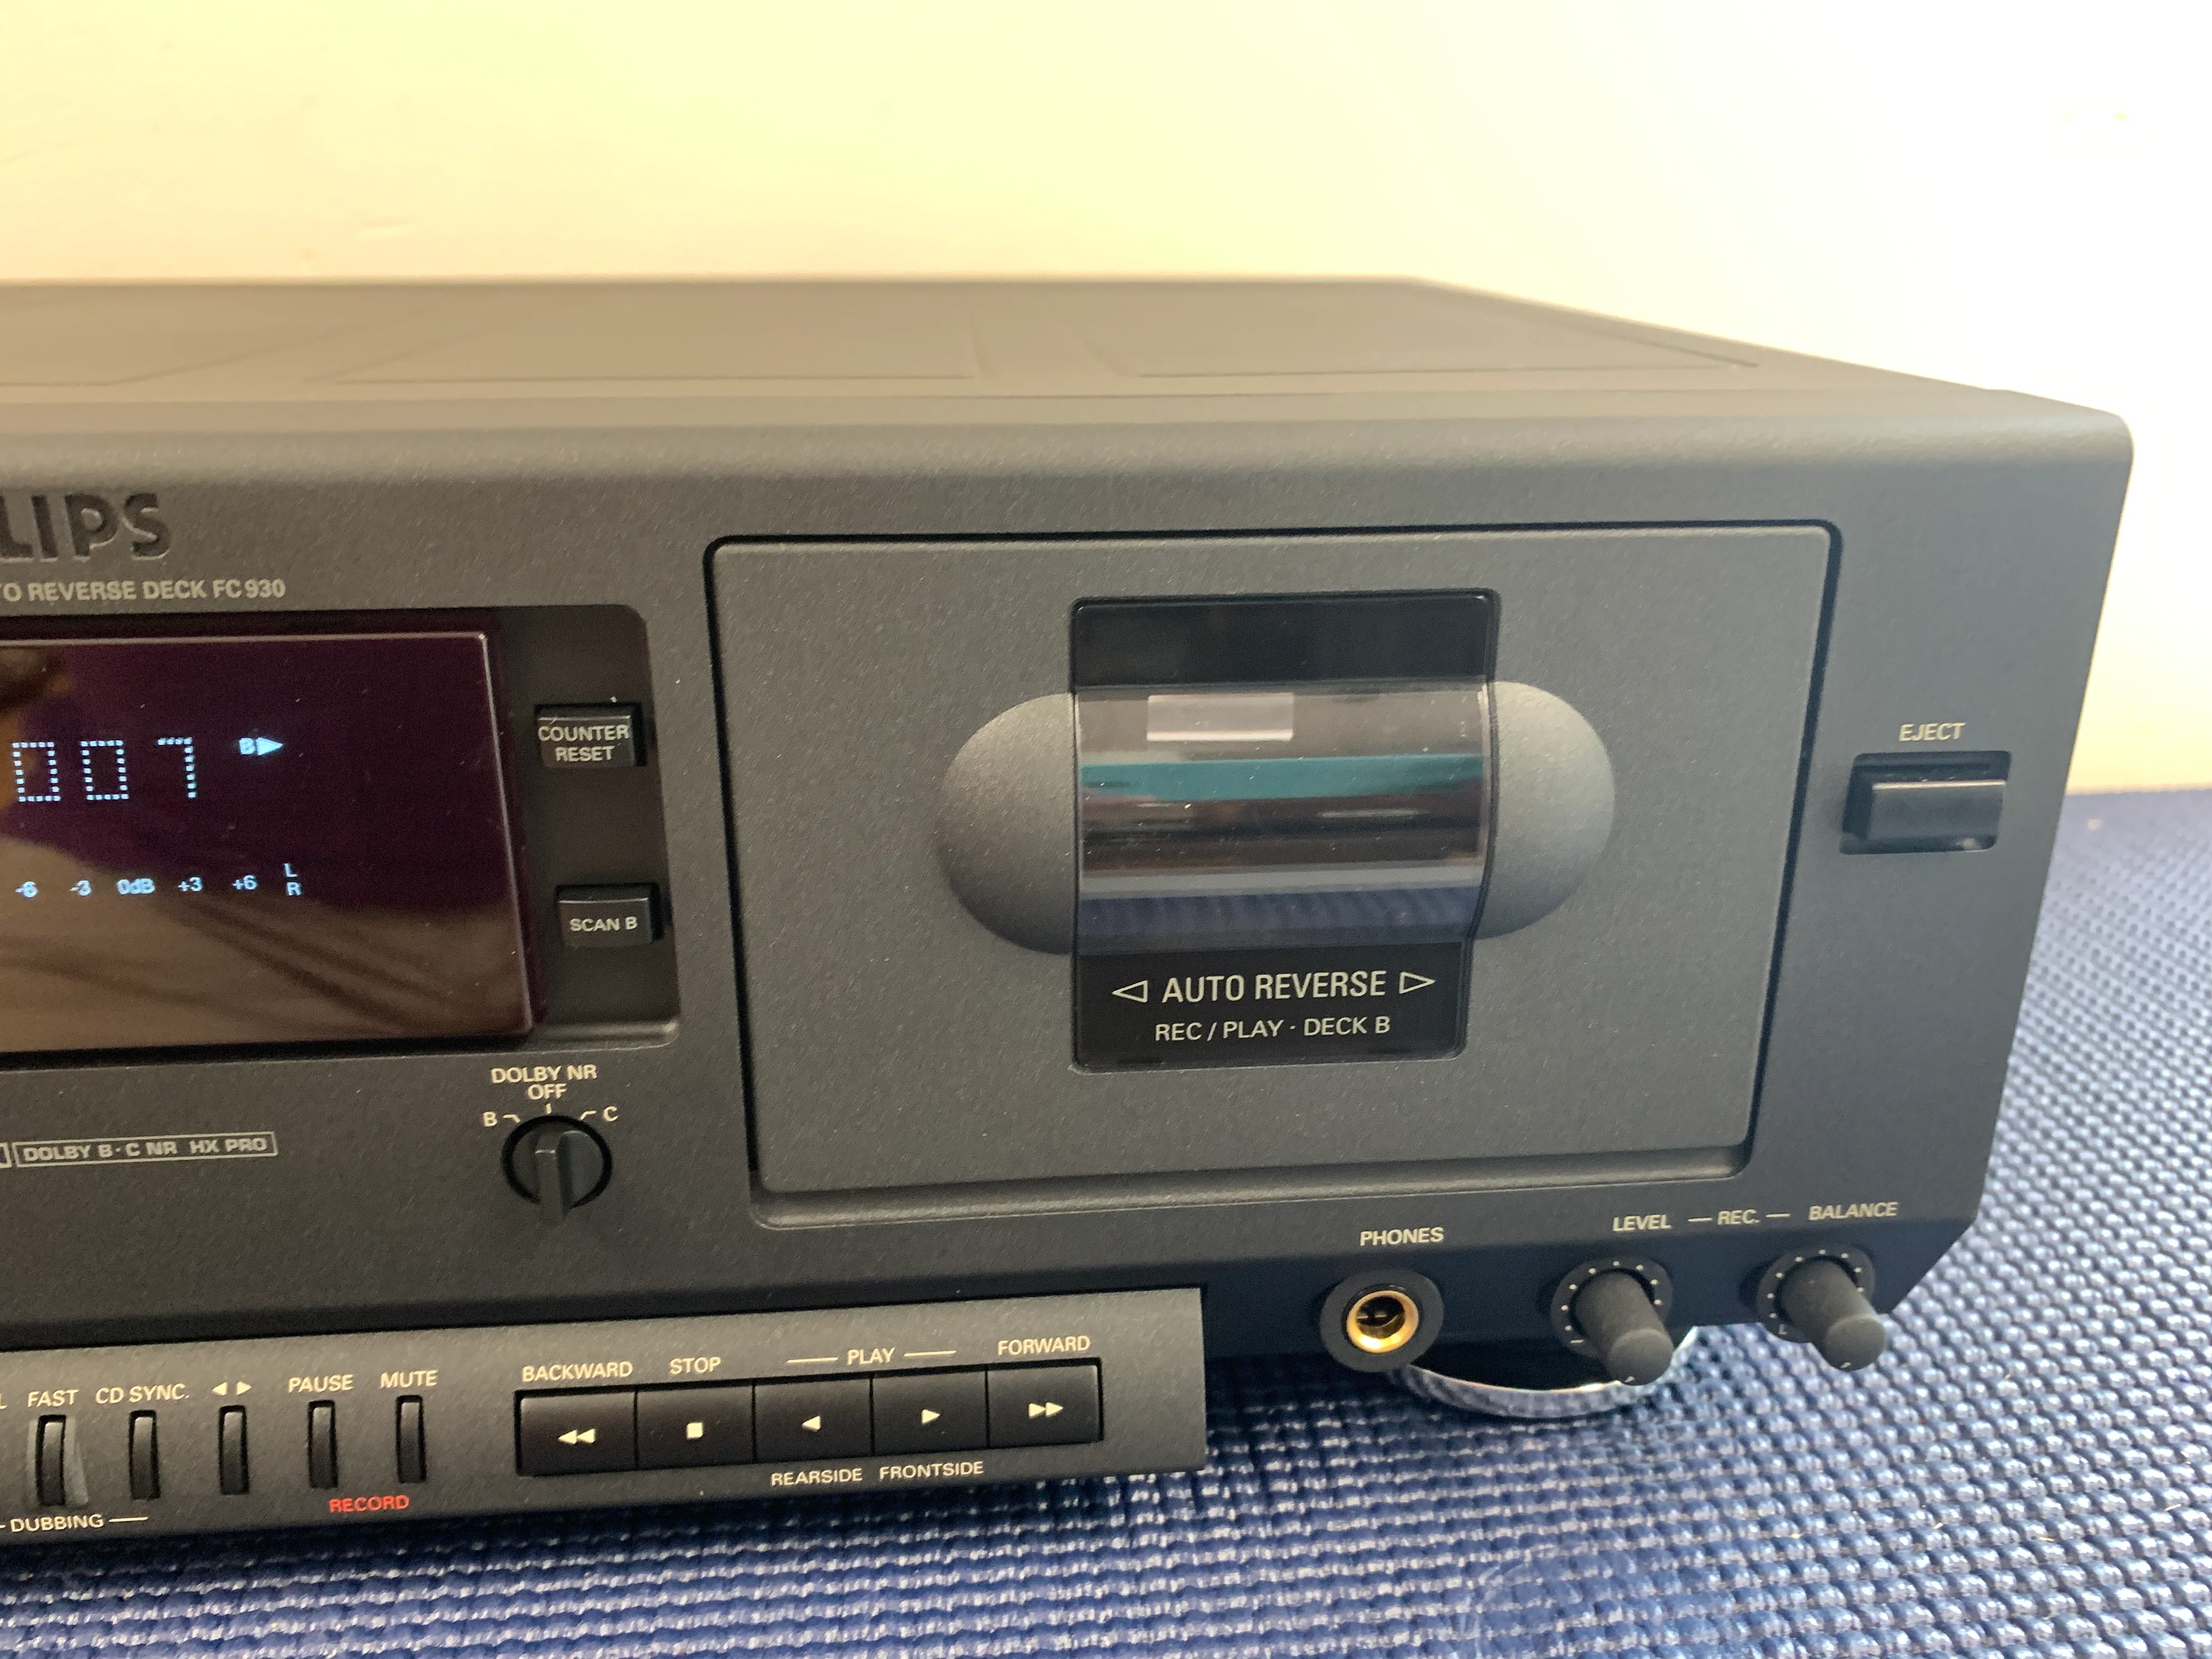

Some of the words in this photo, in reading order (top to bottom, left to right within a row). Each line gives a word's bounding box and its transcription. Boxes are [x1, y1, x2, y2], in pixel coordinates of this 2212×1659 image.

[27, 581, 136, 601] REVERSE
[143, 580, 207, 599] DECK
[539, 725, 629, 741] COUNTER
[1900, 723, 1965, 741] EJECT
[239, 738, 256, 754] B
[555, 746, 614, 761] RESET
[284, 864, 297, 877] L
[117, 878, 155, 894] 0dB
[178, 877, 202, 891] +3
[233, 875, 257, 889] +6
[287, 882, 301, 895] R
[570, 918, 619, 932] SCAN
[625, 917, 637, 929] B
[1163, 975, 1244, 1002] AUTO
[1256, 971, 1386, 999] REVERSE
[1305, 1017, 1367, 1035] DECK
[1375, 1016, 1390, 1033] B
[492, 1066, 561, 1083] DOLBY
[567, 1064, 597, 1080] NR
[528, 1084, 566, 1099] OFF
[483, 1112, 497, 1126] B
[603, 1107, 618, 1121] C
[24, 1145, 91, 1161] DOLBY
[146, 1142, 177, 1155] NR
[190, 1139, 219, 1153] HX
[225, 1138, 267, 1152] PRO
[1809, 1202, 1898, 1220] BALANCE
[1613, 1215, 1671, 1231] LEVEL
[1361, 1227, 1443, 1246] PHONES
[1779, 1324, 1787, 1335] L
[998, 1336, 1091, 1355] FORWARD
[848, 1347, 894, 1364] PLAY
[522, 1361, 633, 1381] BACKWARD
[670, 1357, 721, 1374] STOP
[289, 1374, 353, 1392] PAUSE
[381, 1370, 437, 1388] MUTE
[28, 1389, 78, 1407] FAST
[96, 1387, 124, 1403] CD
[129, 1384, 189, 1402] SYNC.
[771, 1468, 862, 1486] REARSIDE
[880, 1462, 983, 1479] FRONTSIDE
[329, 1495, 409, 1512] RECORD
[10, 1514, 104, 1532] DUBBING
